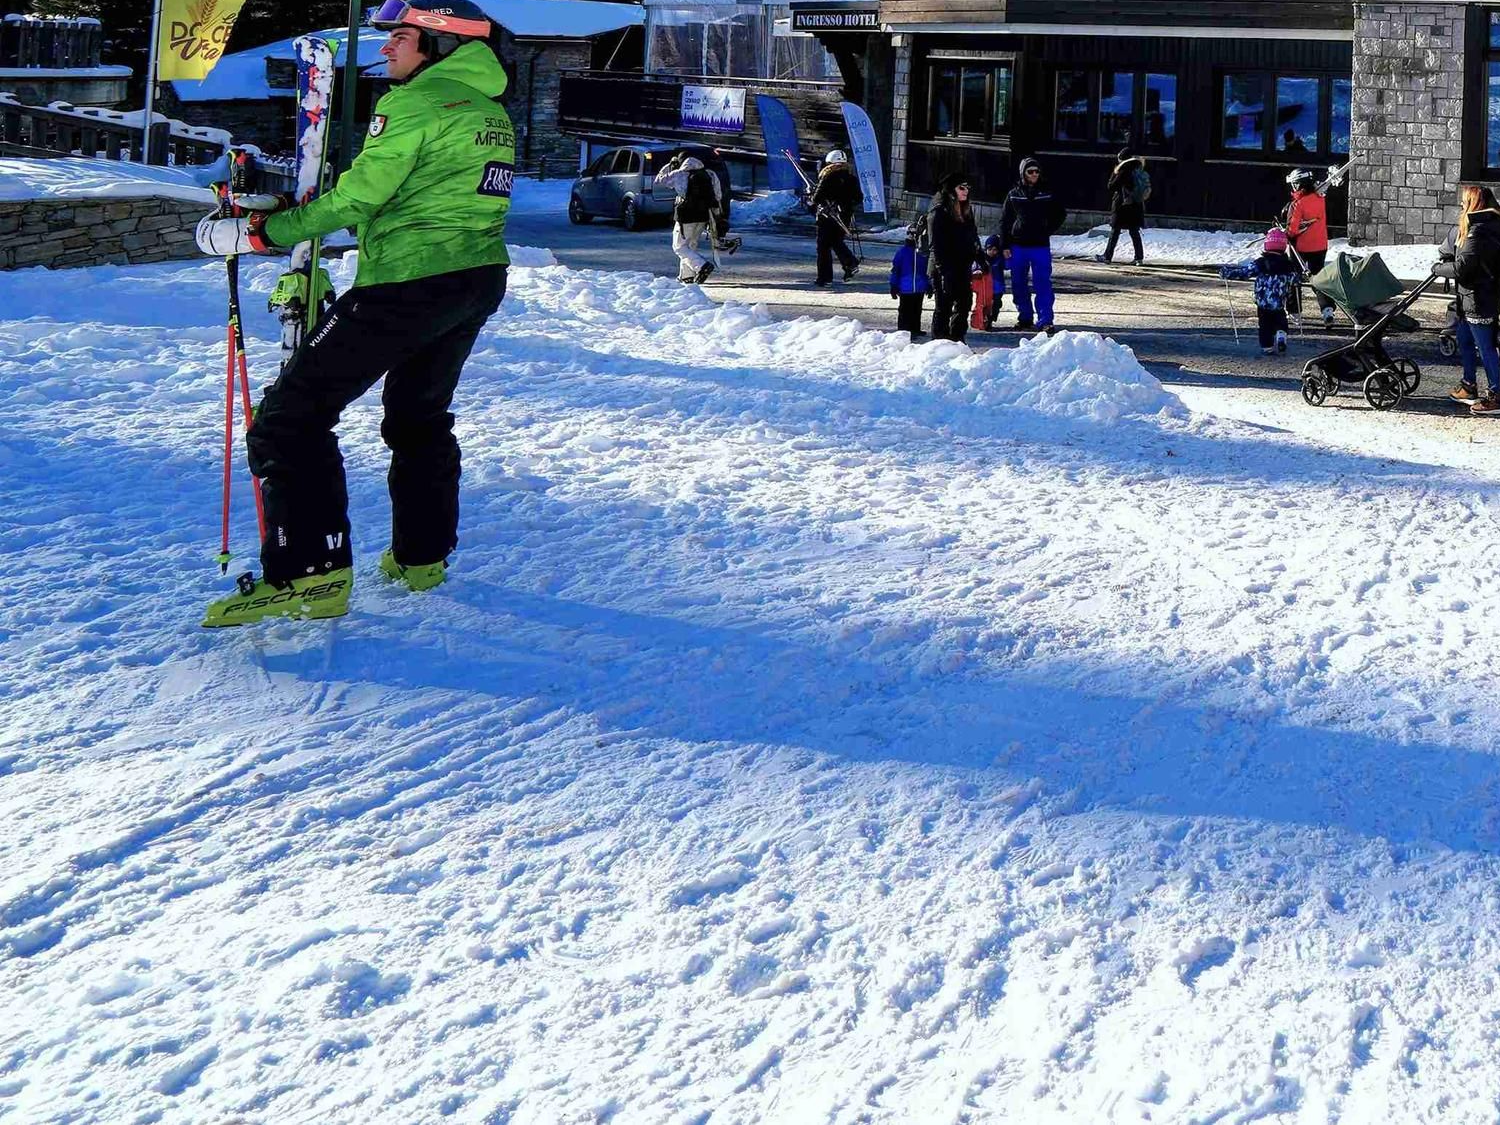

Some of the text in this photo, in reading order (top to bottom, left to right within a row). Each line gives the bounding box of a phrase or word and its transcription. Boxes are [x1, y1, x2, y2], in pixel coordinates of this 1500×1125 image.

[796, 14, 878, 26] INGRESSO HOTEL
[309, 314, 339, 347] VUARNET
[223, 579, 347, 616] FISCHER
